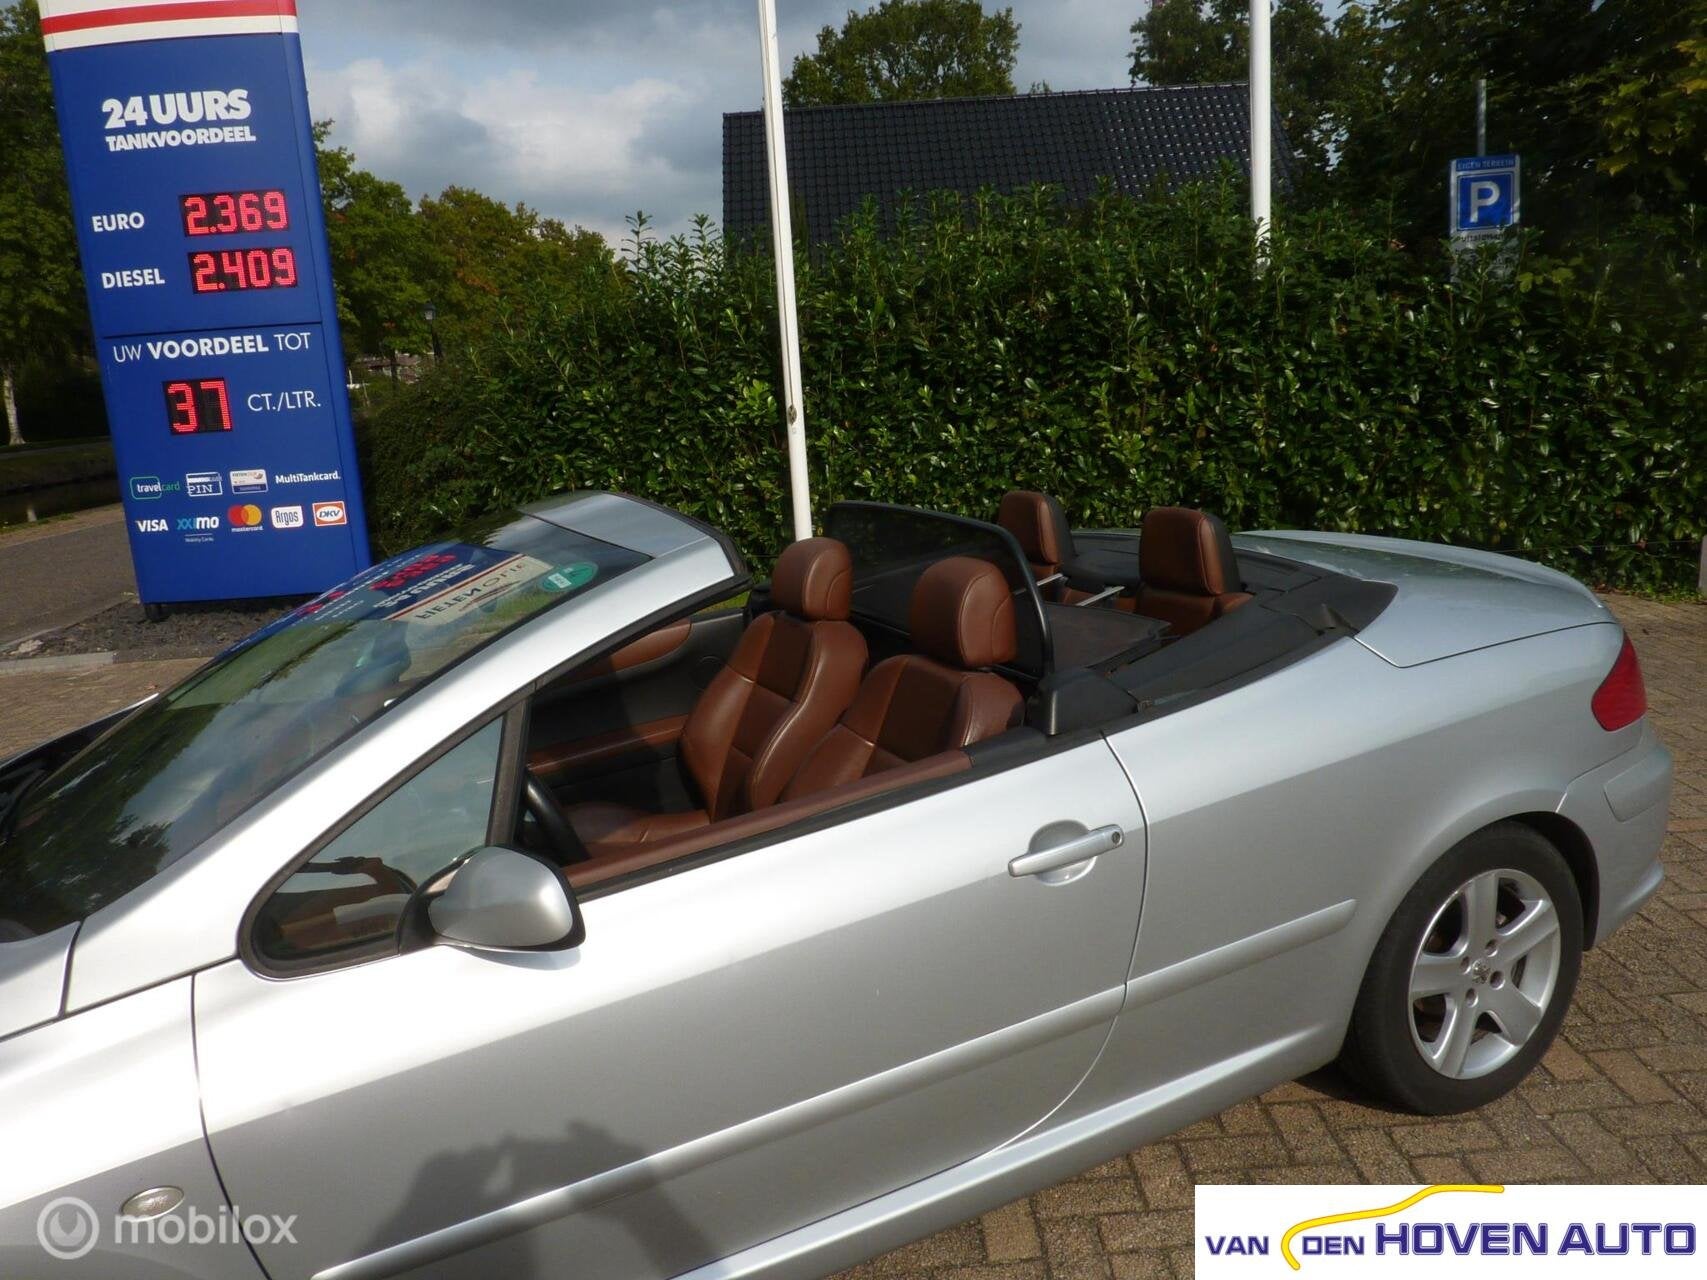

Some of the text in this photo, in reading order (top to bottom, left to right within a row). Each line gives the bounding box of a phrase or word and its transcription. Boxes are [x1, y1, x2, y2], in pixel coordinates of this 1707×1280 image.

[102, 89, 251, 128] 24 UURS
[105, 126, 256, 152] TANKVOORDEEL
[91, 191, 288, 236] EURO 2.369
[1470, 181, 1500, 223] P
[101, 248, 296, 292] DIESEL 2.409
[113, 332, 311, 363] UW VOORDEEL TOT
[167, 380, 321, 432] 37 CT./LTR.
[187, 484, 213, 494] PIN
[136, 519, 169, 533] VISA
[275, 510, 299, 526] Argos
[319, 509, 340, 518] DKV
